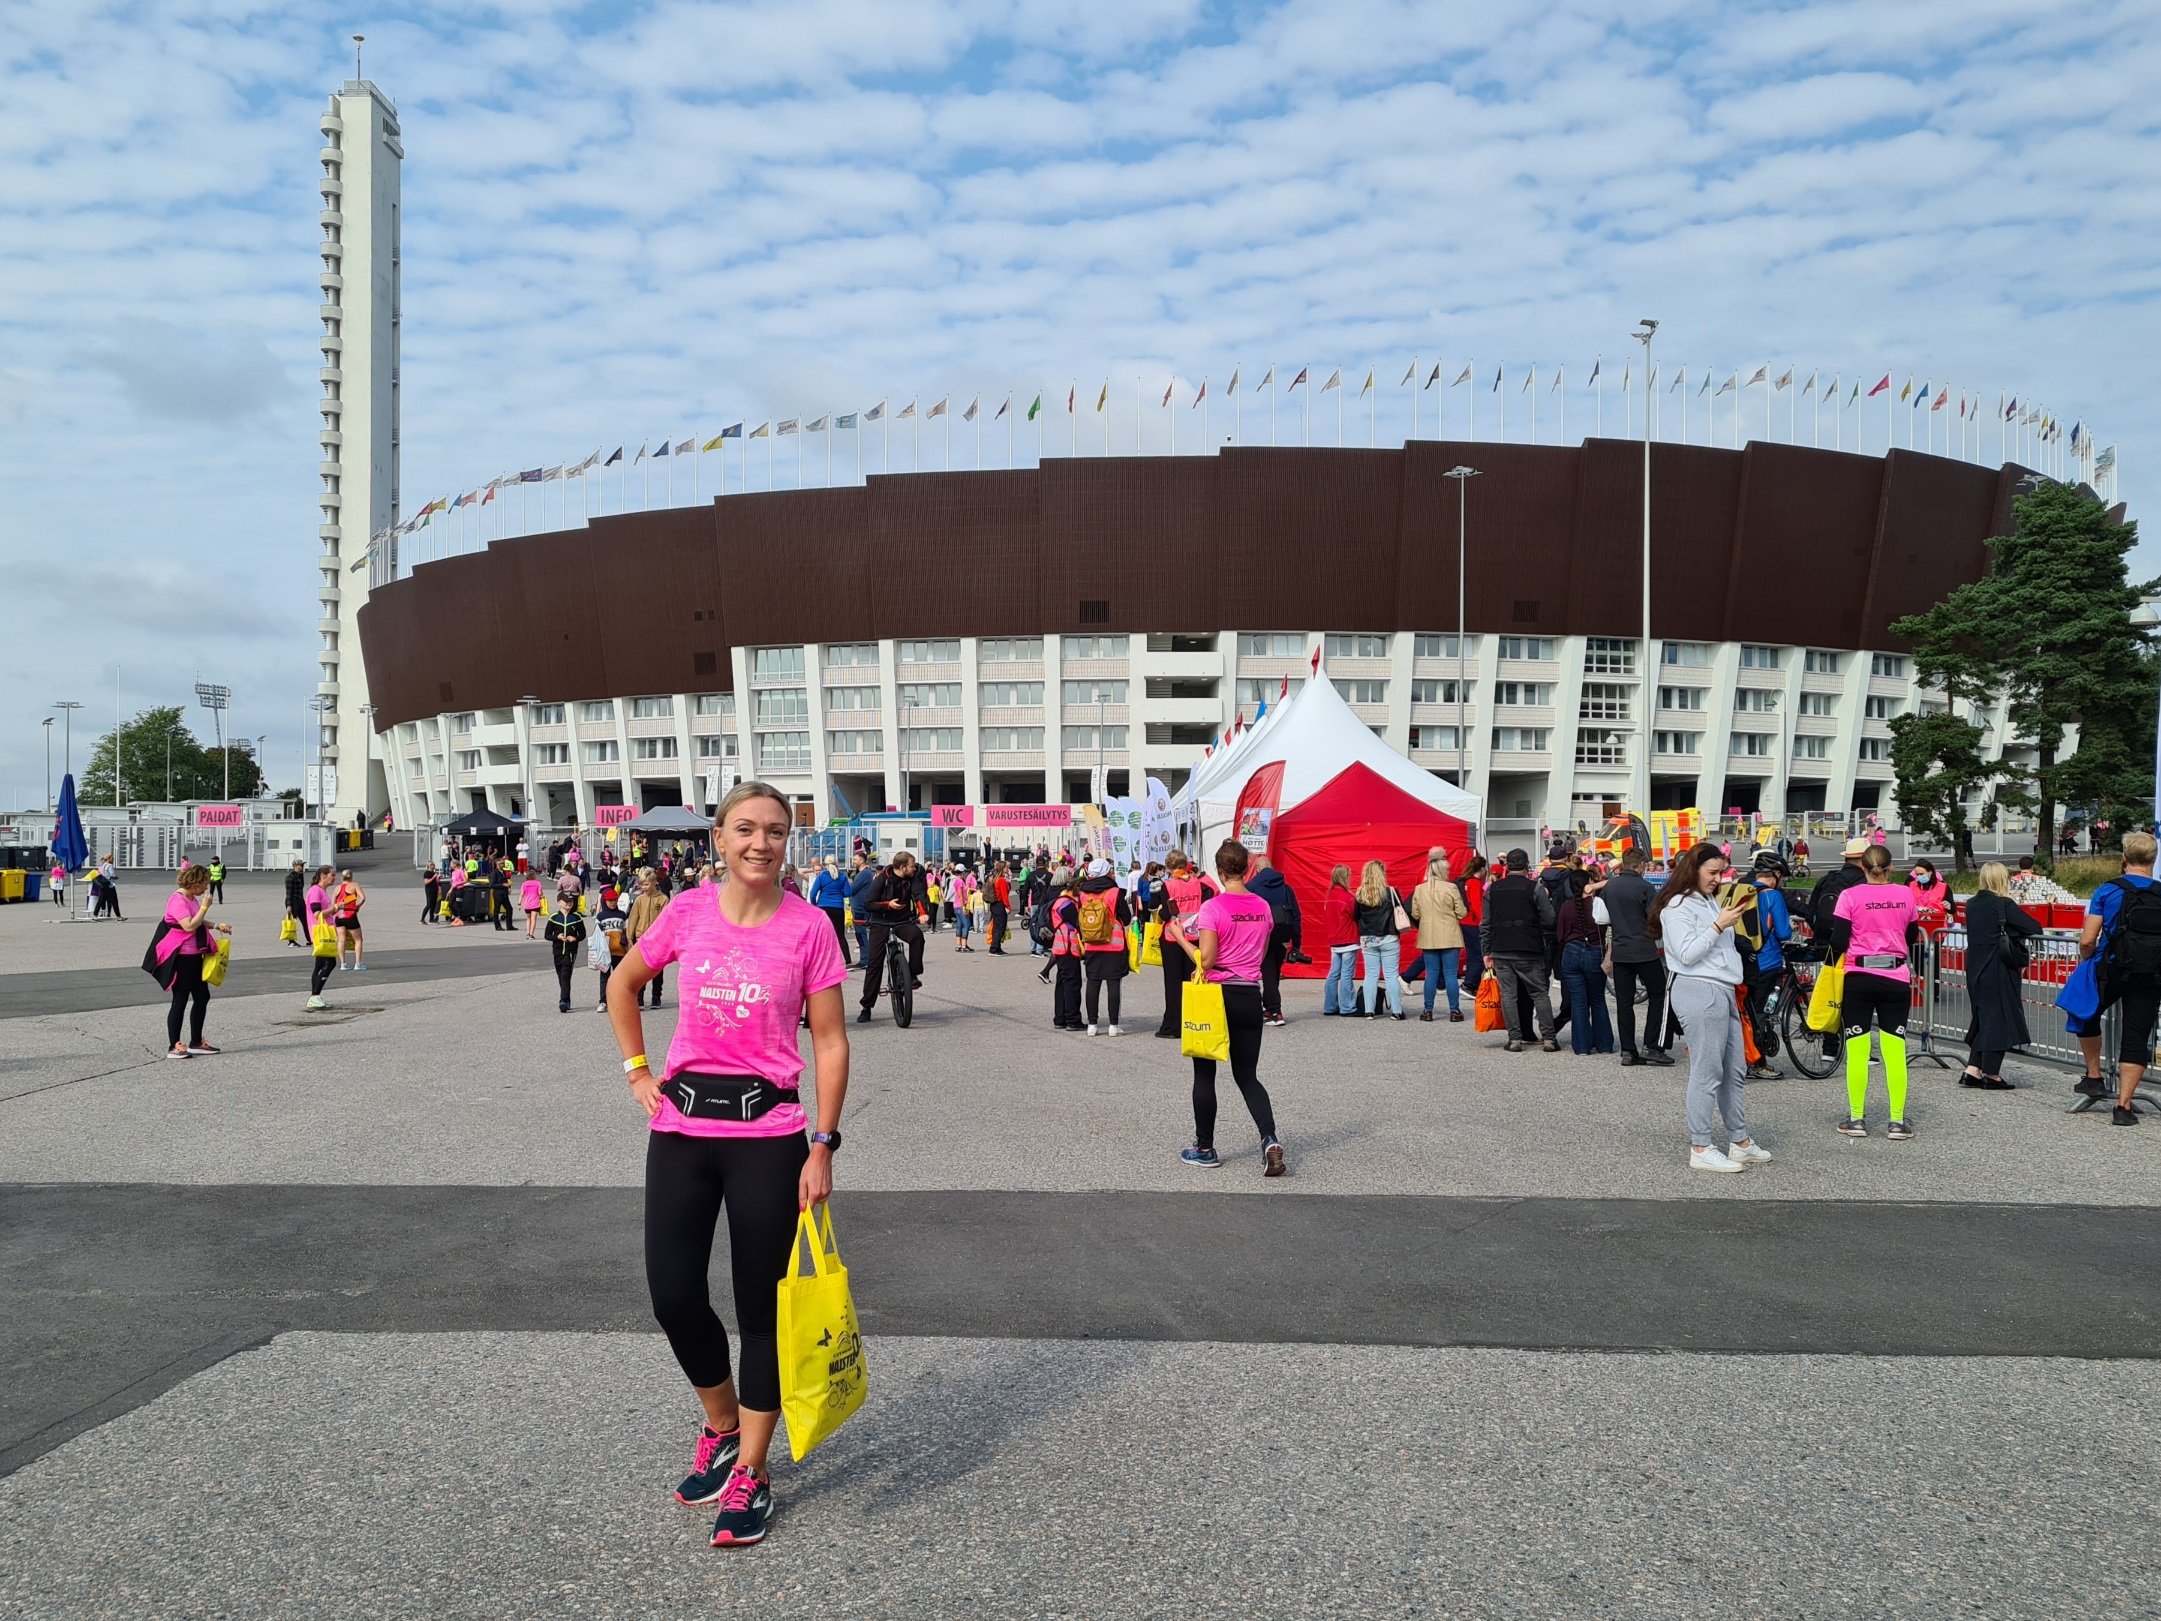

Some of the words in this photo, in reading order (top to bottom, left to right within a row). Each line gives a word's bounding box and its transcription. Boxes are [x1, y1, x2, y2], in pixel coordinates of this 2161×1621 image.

[200, 811, 239, 823] PAIDAT
[601, 809, 632, 824] INFO
[942, 808, 963, 822] WC
[989, 809, 1067, 820] VARUSTESÄILYTYS
[1865, 901, 1906, 910] stadium
[1231, 912, 1266, 922] stadium
[699, 986, 736, 1001] NAISTEN
[738, 982, 761, 1004] 10
